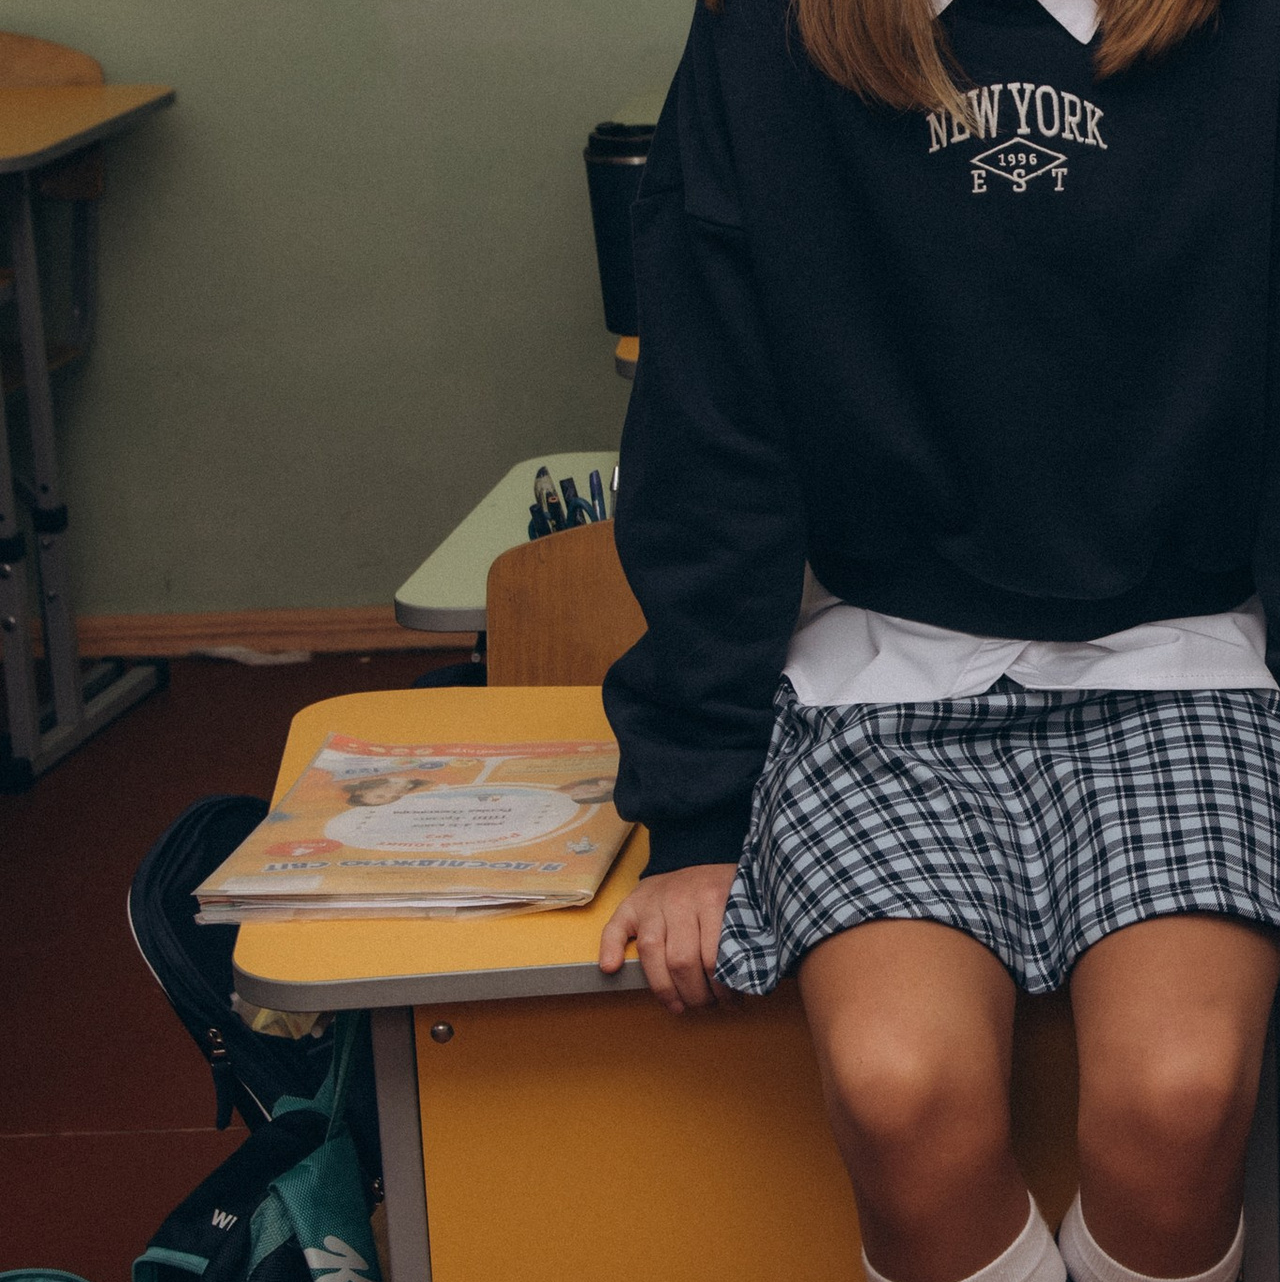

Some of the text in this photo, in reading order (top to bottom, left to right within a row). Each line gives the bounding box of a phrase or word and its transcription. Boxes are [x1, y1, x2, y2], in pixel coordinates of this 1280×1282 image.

[926, 82, 1108, 154] NEW YORK
[998, 153, 1038, 166] 1996
[262, 858, 566, 872] Я ДОСЛІДЖУЮ СВІТ
